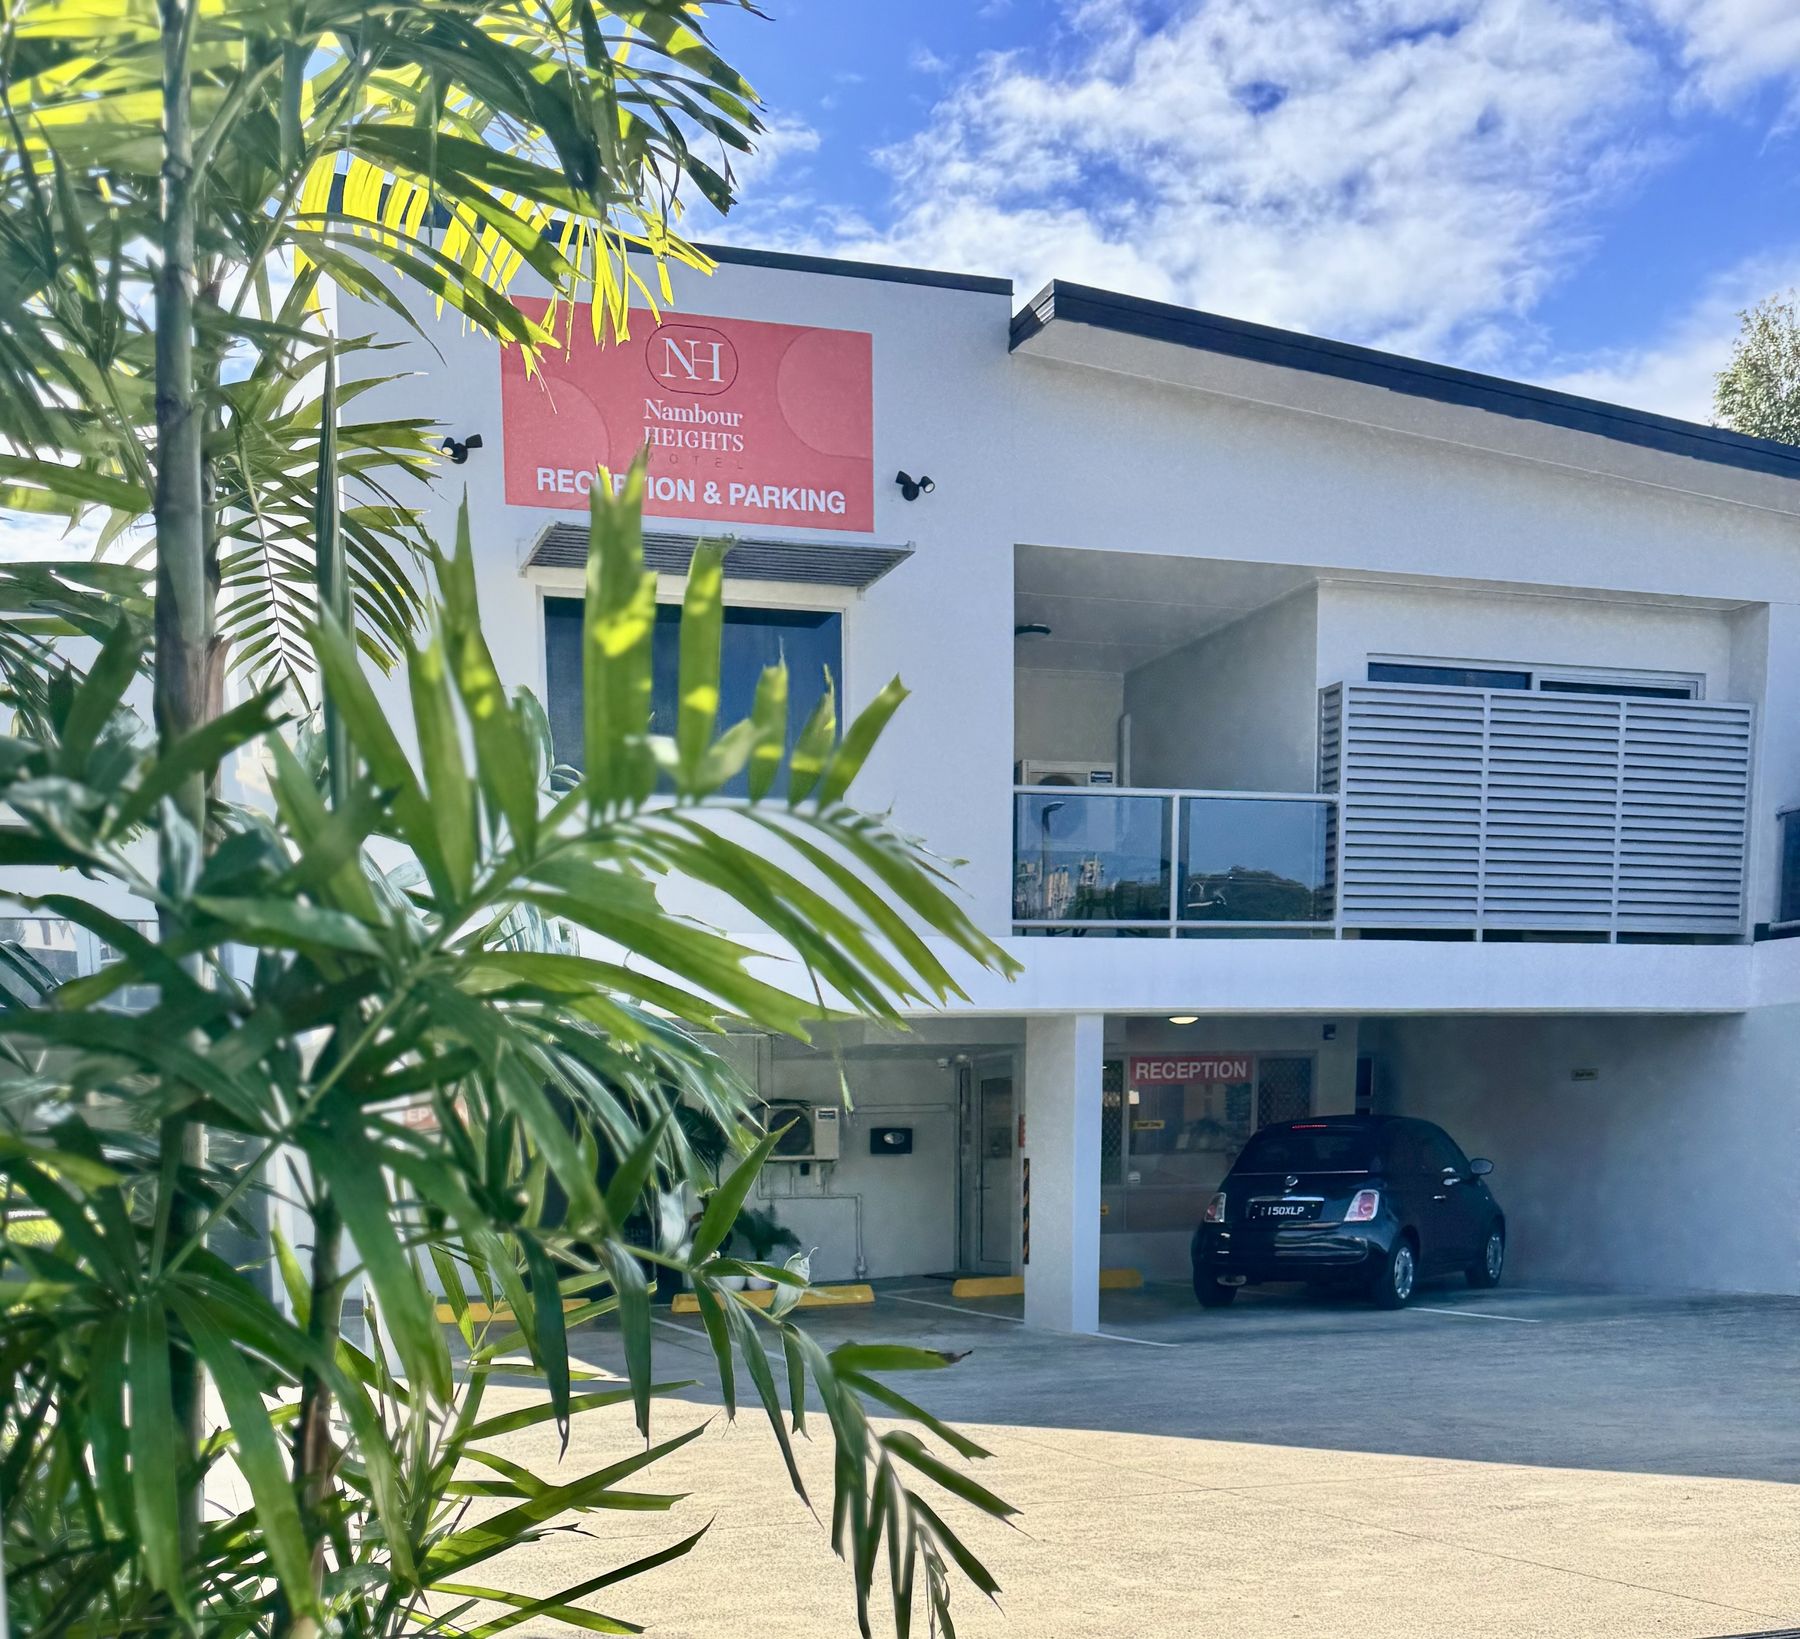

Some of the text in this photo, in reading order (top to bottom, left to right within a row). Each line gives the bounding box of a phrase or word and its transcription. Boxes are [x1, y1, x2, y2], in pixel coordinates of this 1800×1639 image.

[660, 337, 725, 383] NH
[643, 398, 743, 428] Nambour
[643, 427, 744, 452] HEIGHTS
[703, 481, 722, 503] &
[730, 482, 847, 514] PARKING
[1136, 1062, 1246, 1079] RECEPTION
